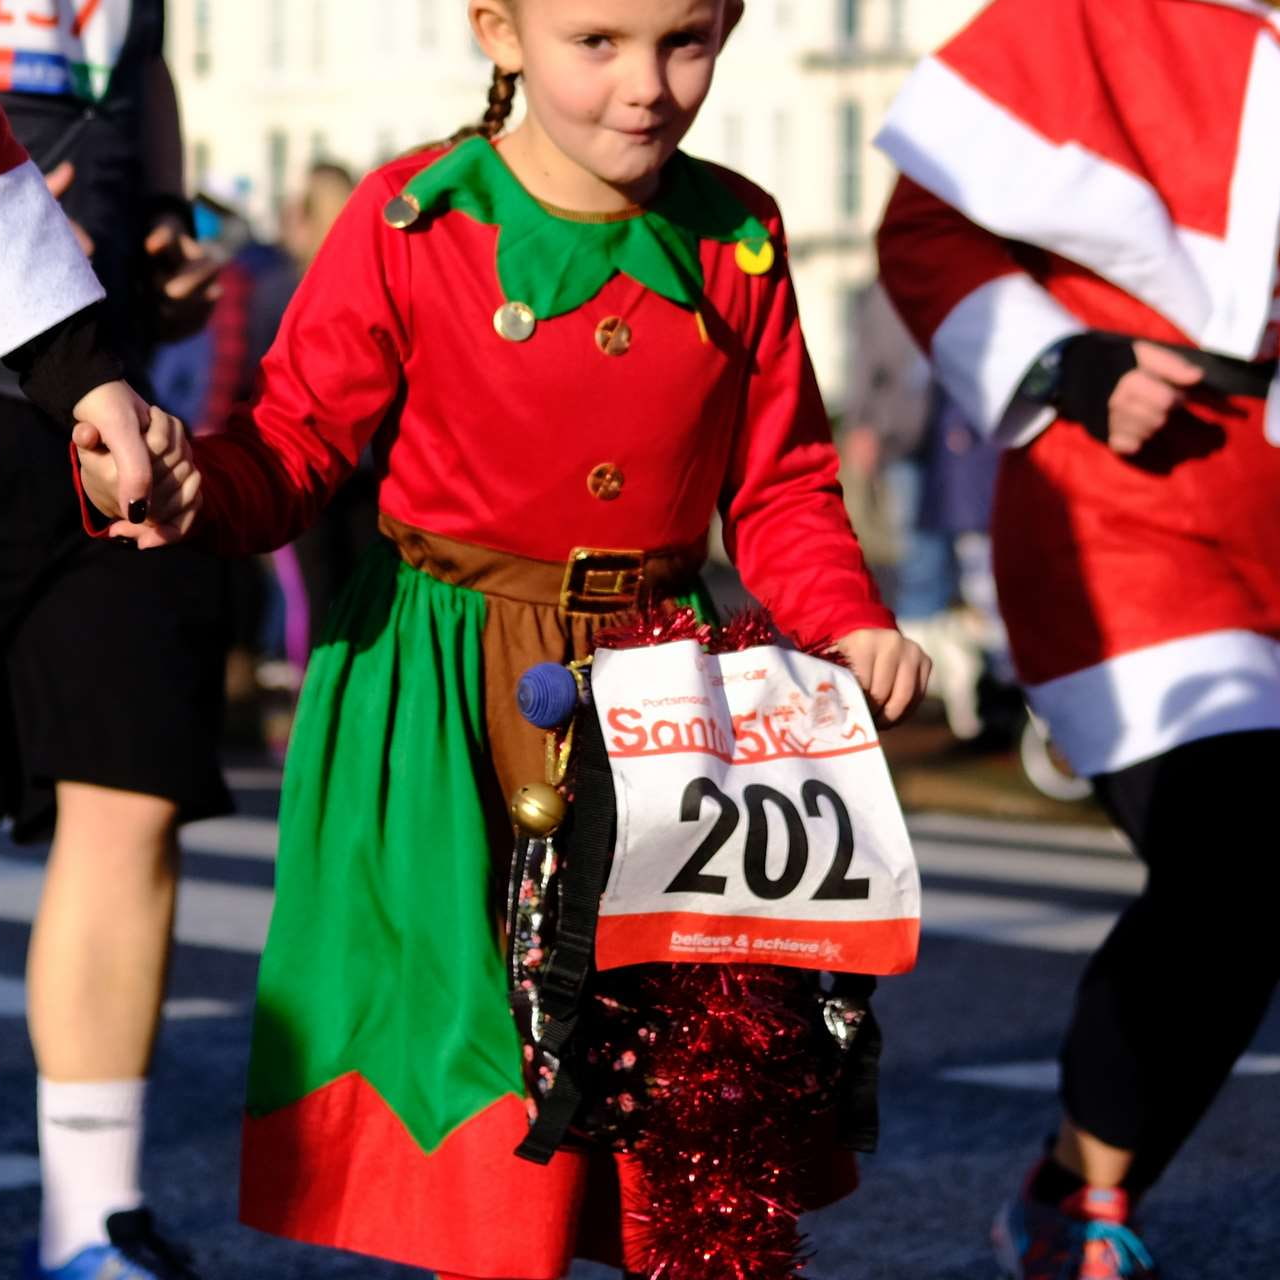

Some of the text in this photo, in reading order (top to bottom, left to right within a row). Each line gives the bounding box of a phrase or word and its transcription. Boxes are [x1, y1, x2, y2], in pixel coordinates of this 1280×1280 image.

[663, 776, 870, 900] 202
[671, 931, 733, 946] believe
[735, 933, 749, 947] &
[752, 938, 819, 953] achieve
